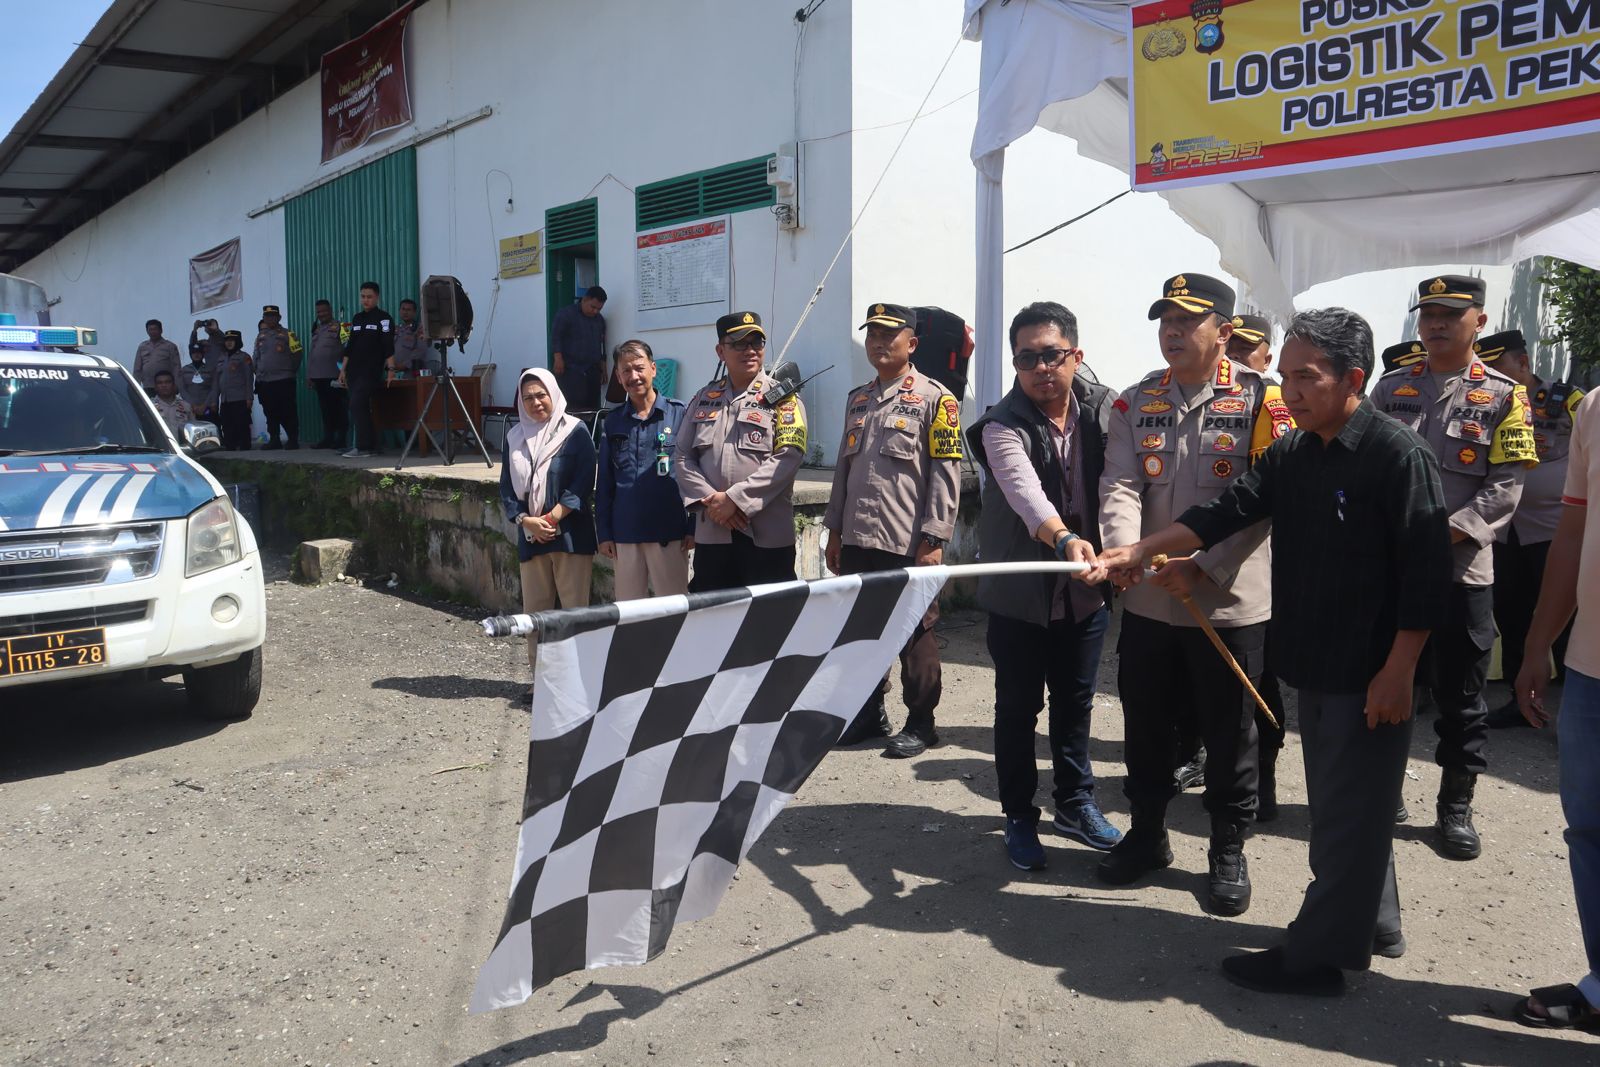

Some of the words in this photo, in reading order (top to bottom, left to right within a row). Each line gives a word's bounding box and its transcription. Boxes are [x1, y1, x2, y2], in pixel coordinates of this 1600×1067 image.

[1302, 0, 1433, 33] POS
[1210, 15, 1444, 101] LOGISTIK
[1460, 0, 1600, 57] PEM
[1284, 67, 1494, 131] POLRESTA
[1507, 42, 1600, 97] PEK
[1173, 141, 1263, 167] PRESISI
[78, 369, 111, 379] 902
[891, 404, 921, 417] POLRI
[1453, 407, 1496, 422] POLRI
[1136, 416, 1173, 428] JEKI
[1205, 417, 1250, 430] POLRI
[0, 548, 56, 561] ISUZU
[47, 634, 65, 648] IV
[17, 652, 55, 672] 1115
[77, 646, 102, 665] 28
